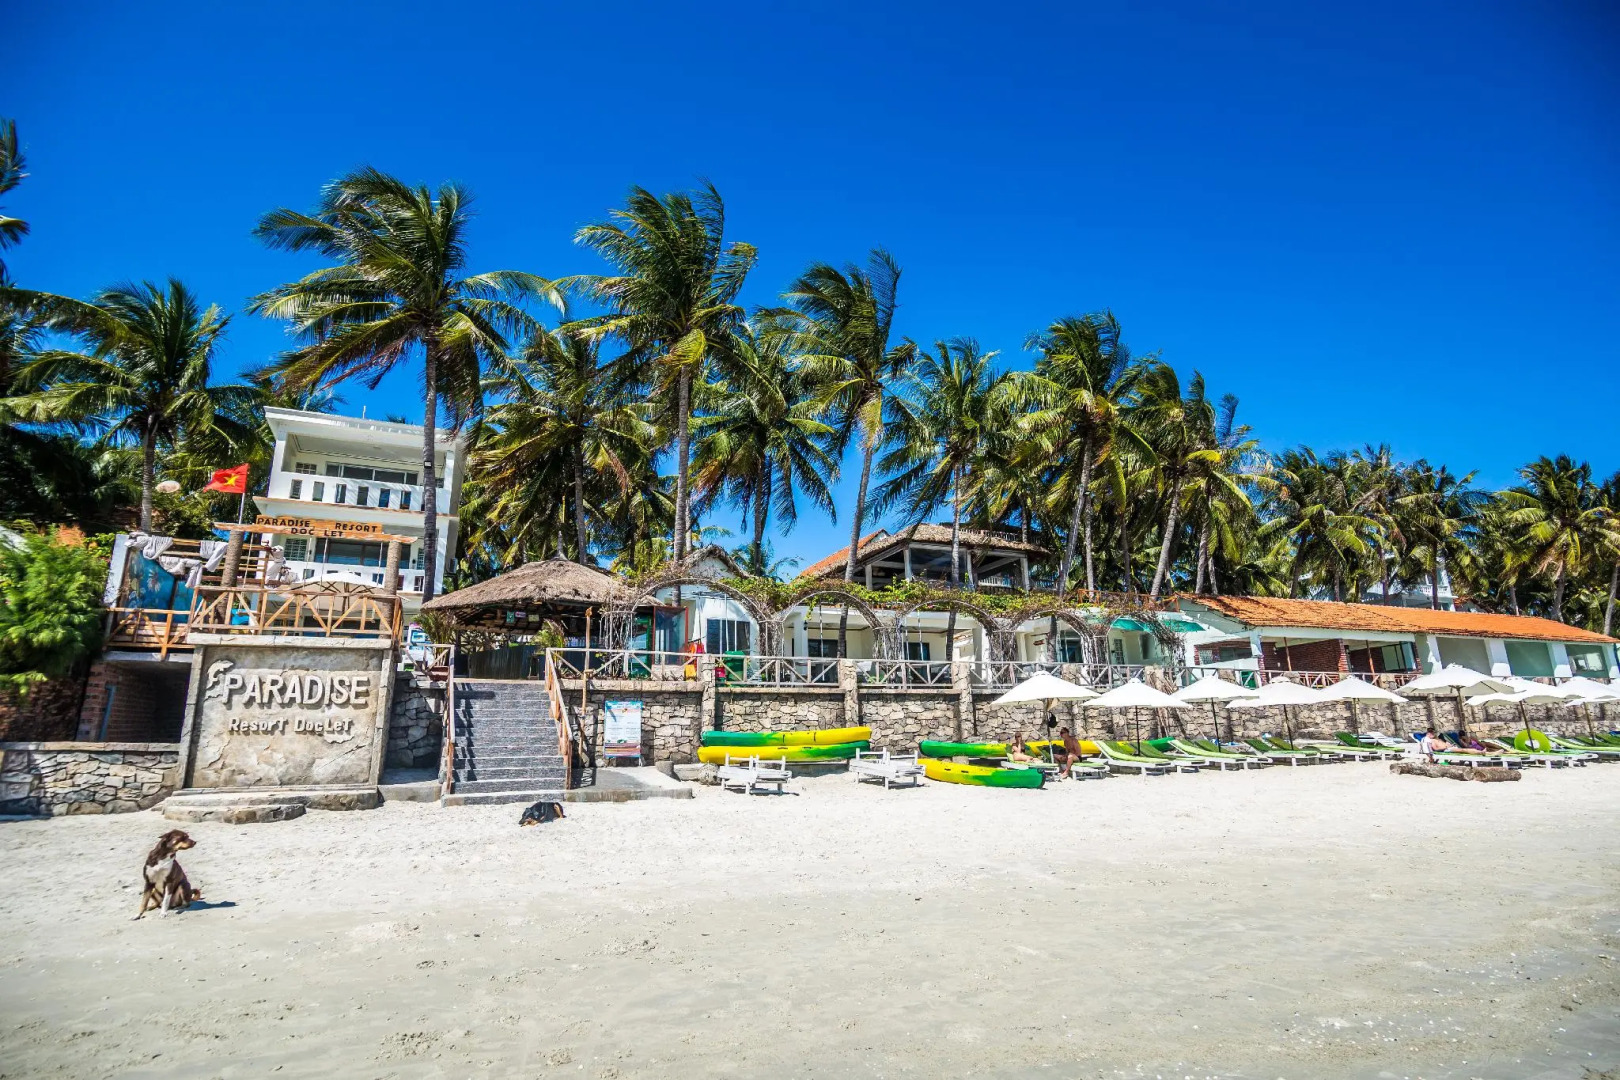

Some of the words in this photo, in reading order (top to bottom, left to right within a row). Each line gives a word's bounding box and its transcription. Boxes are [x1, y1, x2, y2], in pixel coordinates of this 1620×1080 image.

[257, 518, 311, 527] PARADISE
[335, 522, 378, 532] RESORT
[291, 527, 315, 535] DOC
[222, 673, 369, 705] PARADISE
